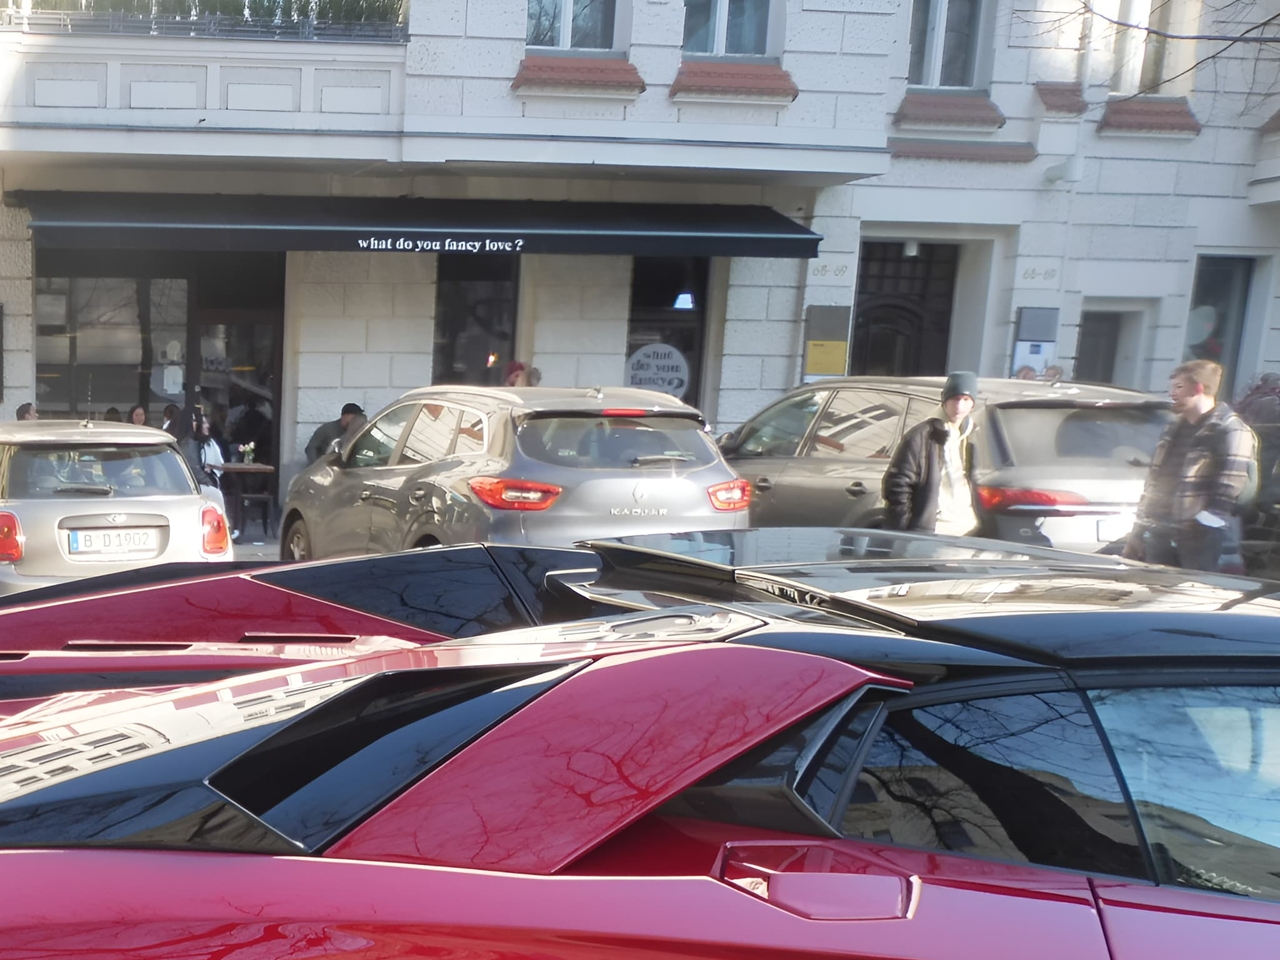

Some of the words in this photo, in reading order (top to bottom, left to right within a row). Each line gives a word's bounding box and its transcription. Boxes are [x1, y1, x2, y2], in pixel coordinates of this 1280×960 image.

[358, 237, 392, 250] what
[396, 237, 412, 250] do
[415, 240, 440, 251] you
[445, 238, 481, 252] fancy
[485, 239, 512, 251] love
